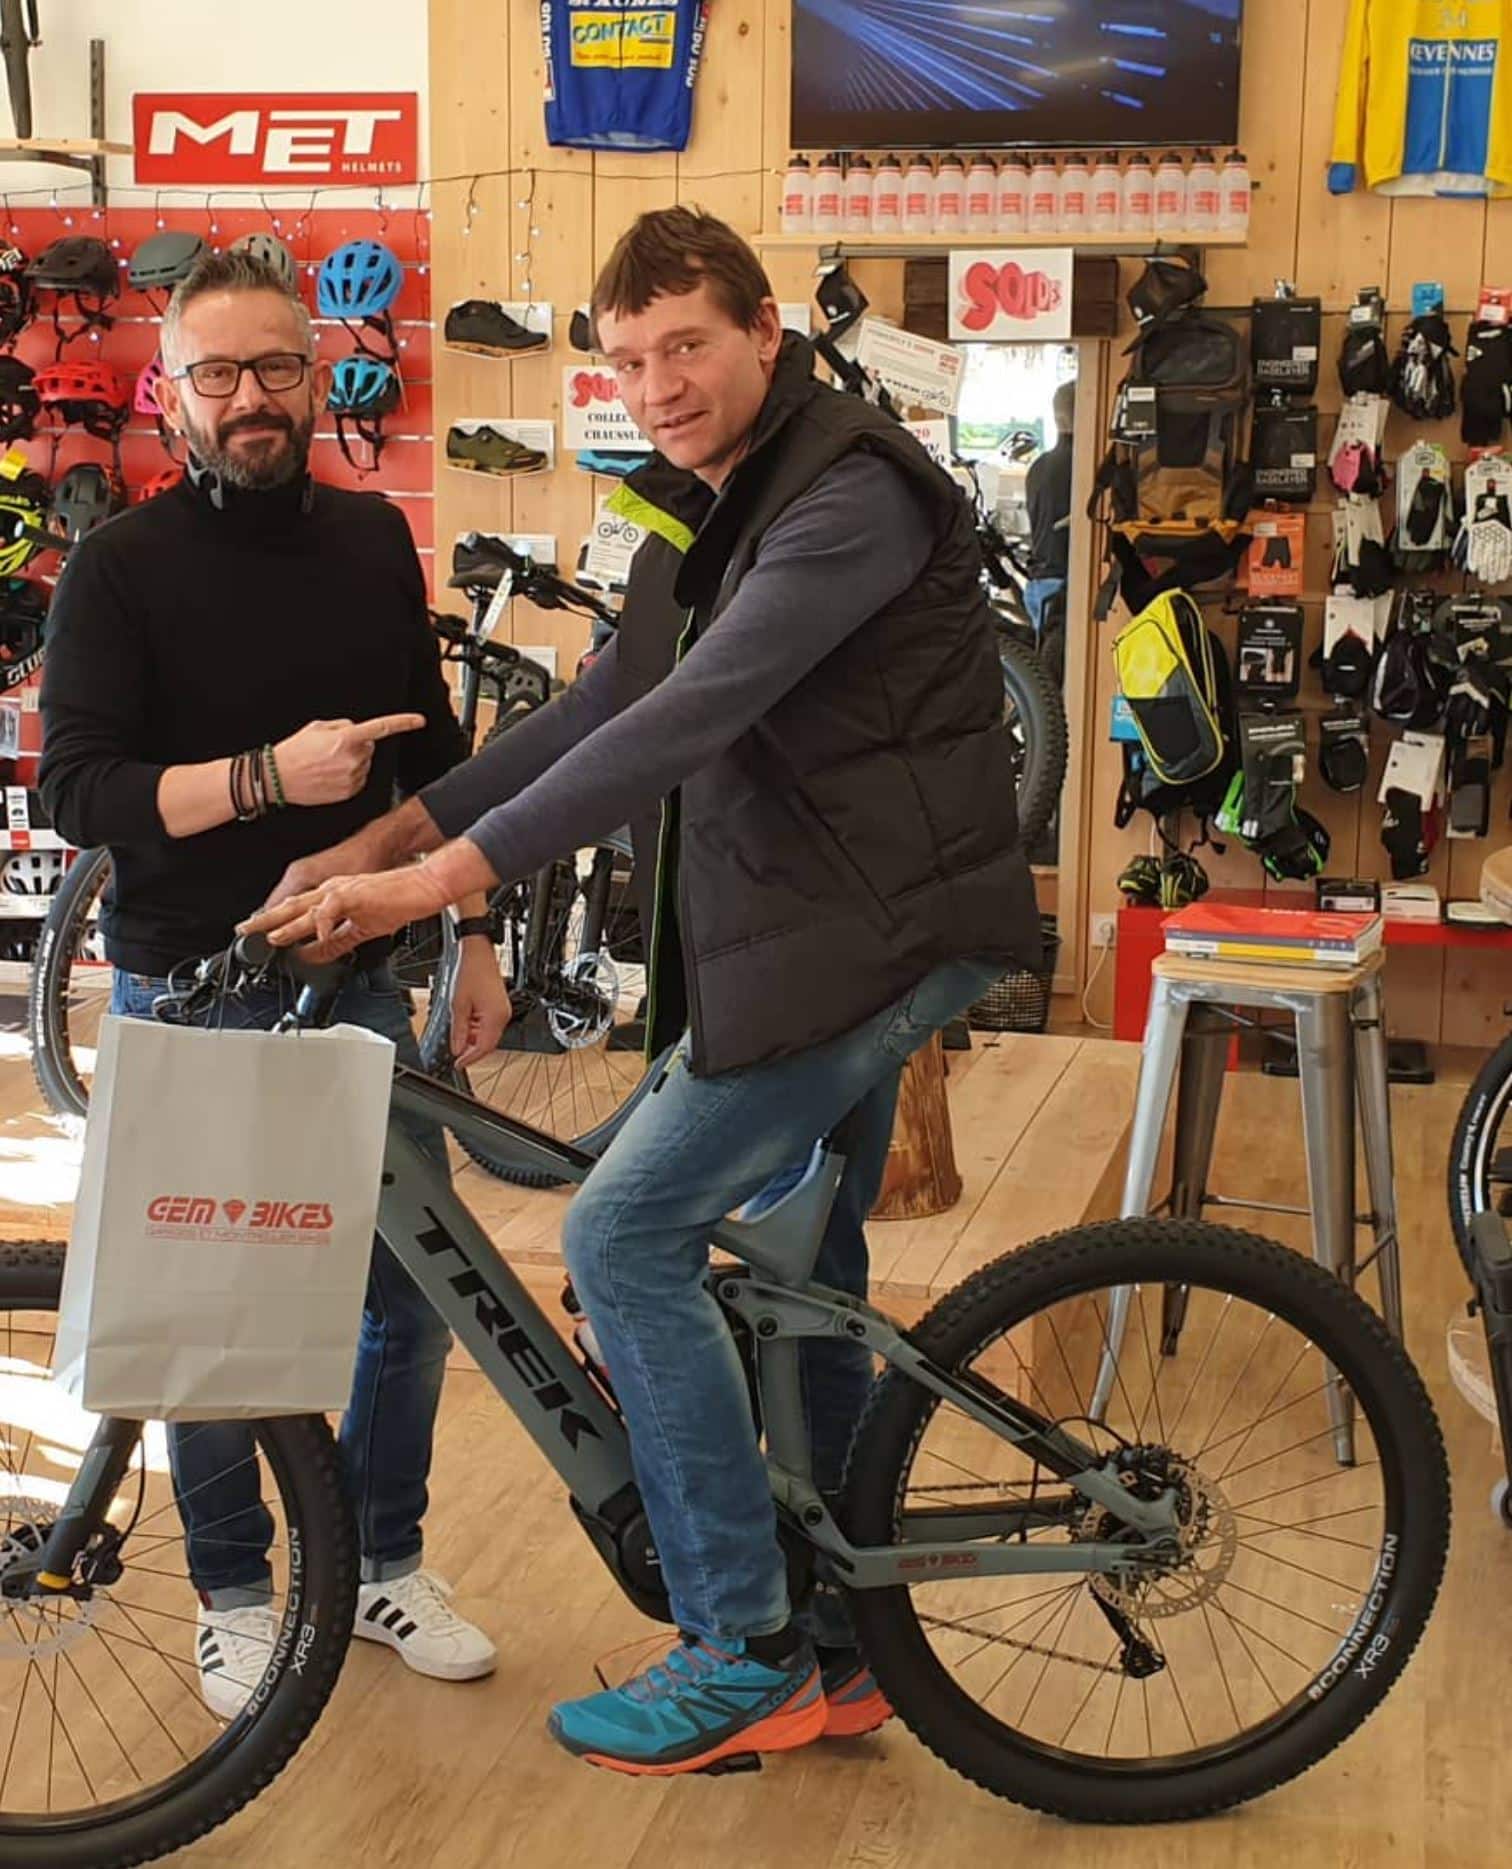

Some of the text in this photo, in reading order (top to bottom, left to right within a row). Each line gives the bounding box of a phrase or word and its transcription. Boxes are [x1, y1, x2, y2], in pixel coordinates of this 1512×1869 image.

[573, 13, 668, 44] CONTACT
[148, 110, 402, 173] MET
[341, 162, 402, 173] HELMETS
[147, 1195, 334, 1230] GEM BIKES
[415, 1206, 604, 1452] TREK
[290, 1623, 315, 1676] XR3
[1354, 1633, 1390, 1679] XR3
